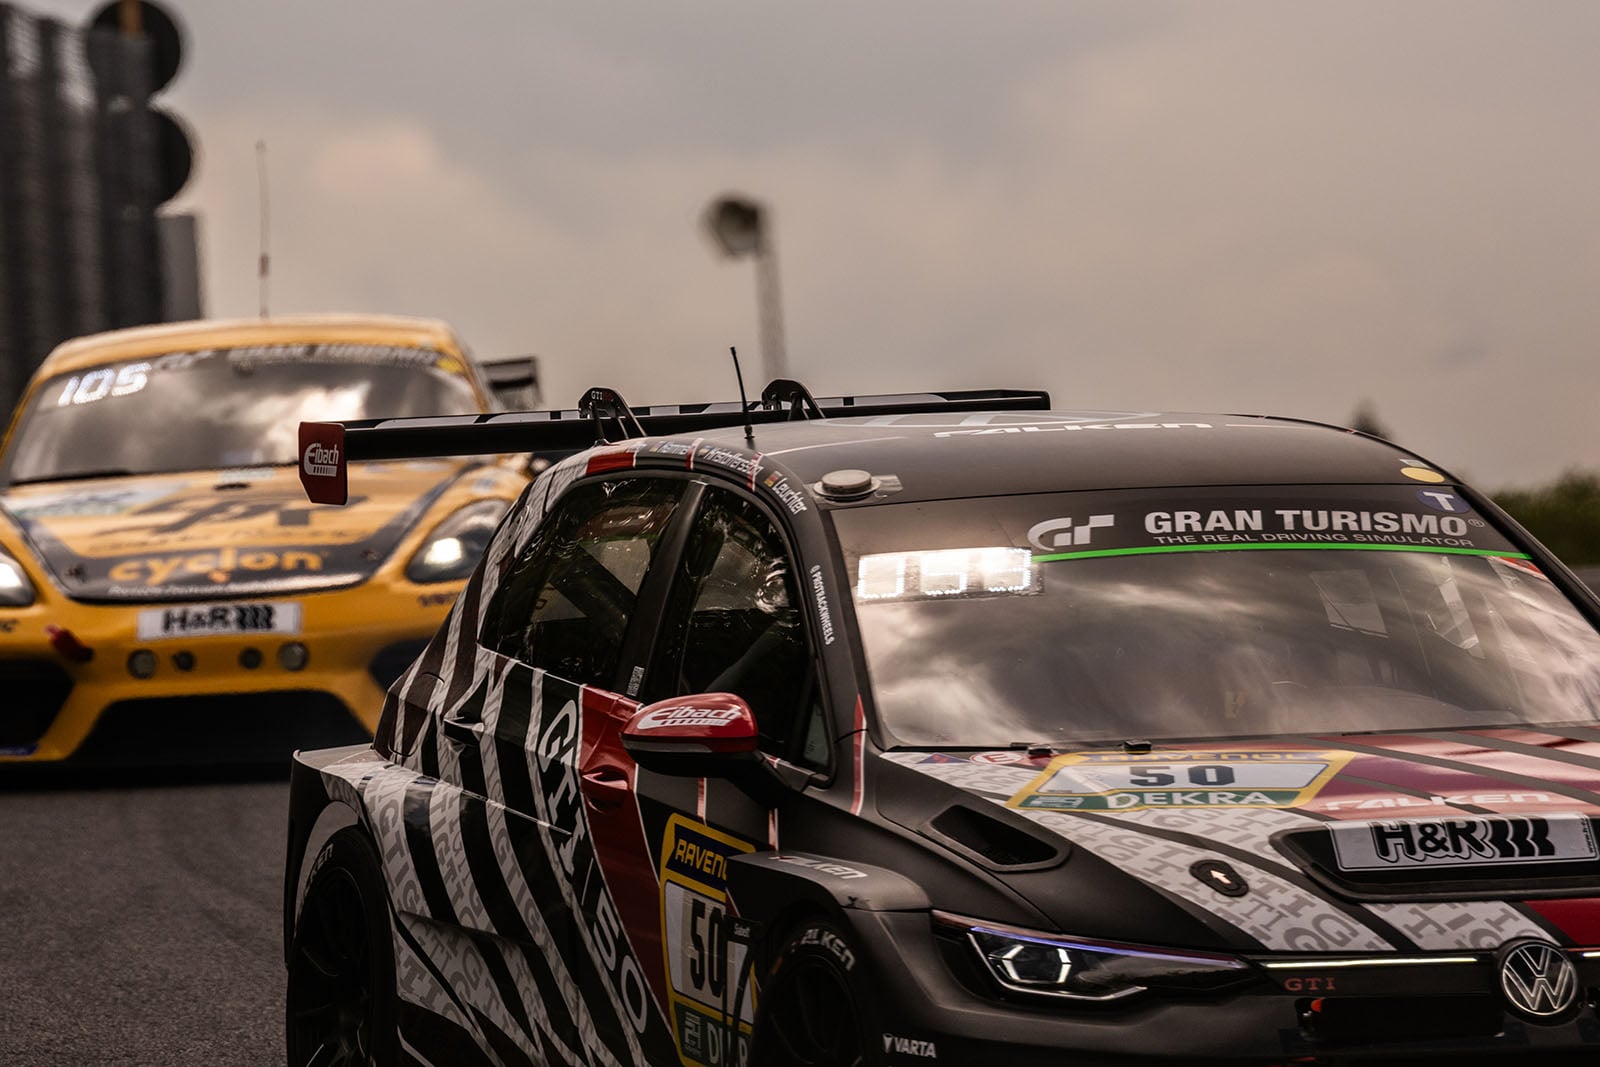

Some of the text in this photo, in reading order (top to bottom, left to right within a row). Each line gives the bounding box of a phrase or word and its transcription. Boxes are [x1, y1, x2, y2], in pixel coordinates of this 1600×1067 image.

[58, 362, 152, 406] 105
[934, 423, 1213, 438] FALKEN
[303, 443, 339, 477] Eibach
[772, 477, 808, 516] Leuchter
[1144, 509, 1468, 537] GRAN TURISMO
[1154, 533, 1475, 547] THE REAL DRIVING SIMULATOR
[108, 547, 324, 585] cyclon
[637, 705, 742, 729] Eibach
[1129, 765, 1236, 787] 50
[1106, 791, 1279, 810] DEKRA
[1324, 793, 1550, 811] FALKEN
[1372, 818, 1494, 863] H&R
[1283, 976, 1337, 992] GTI
[894, 1036, 937, 1059] VARTA
